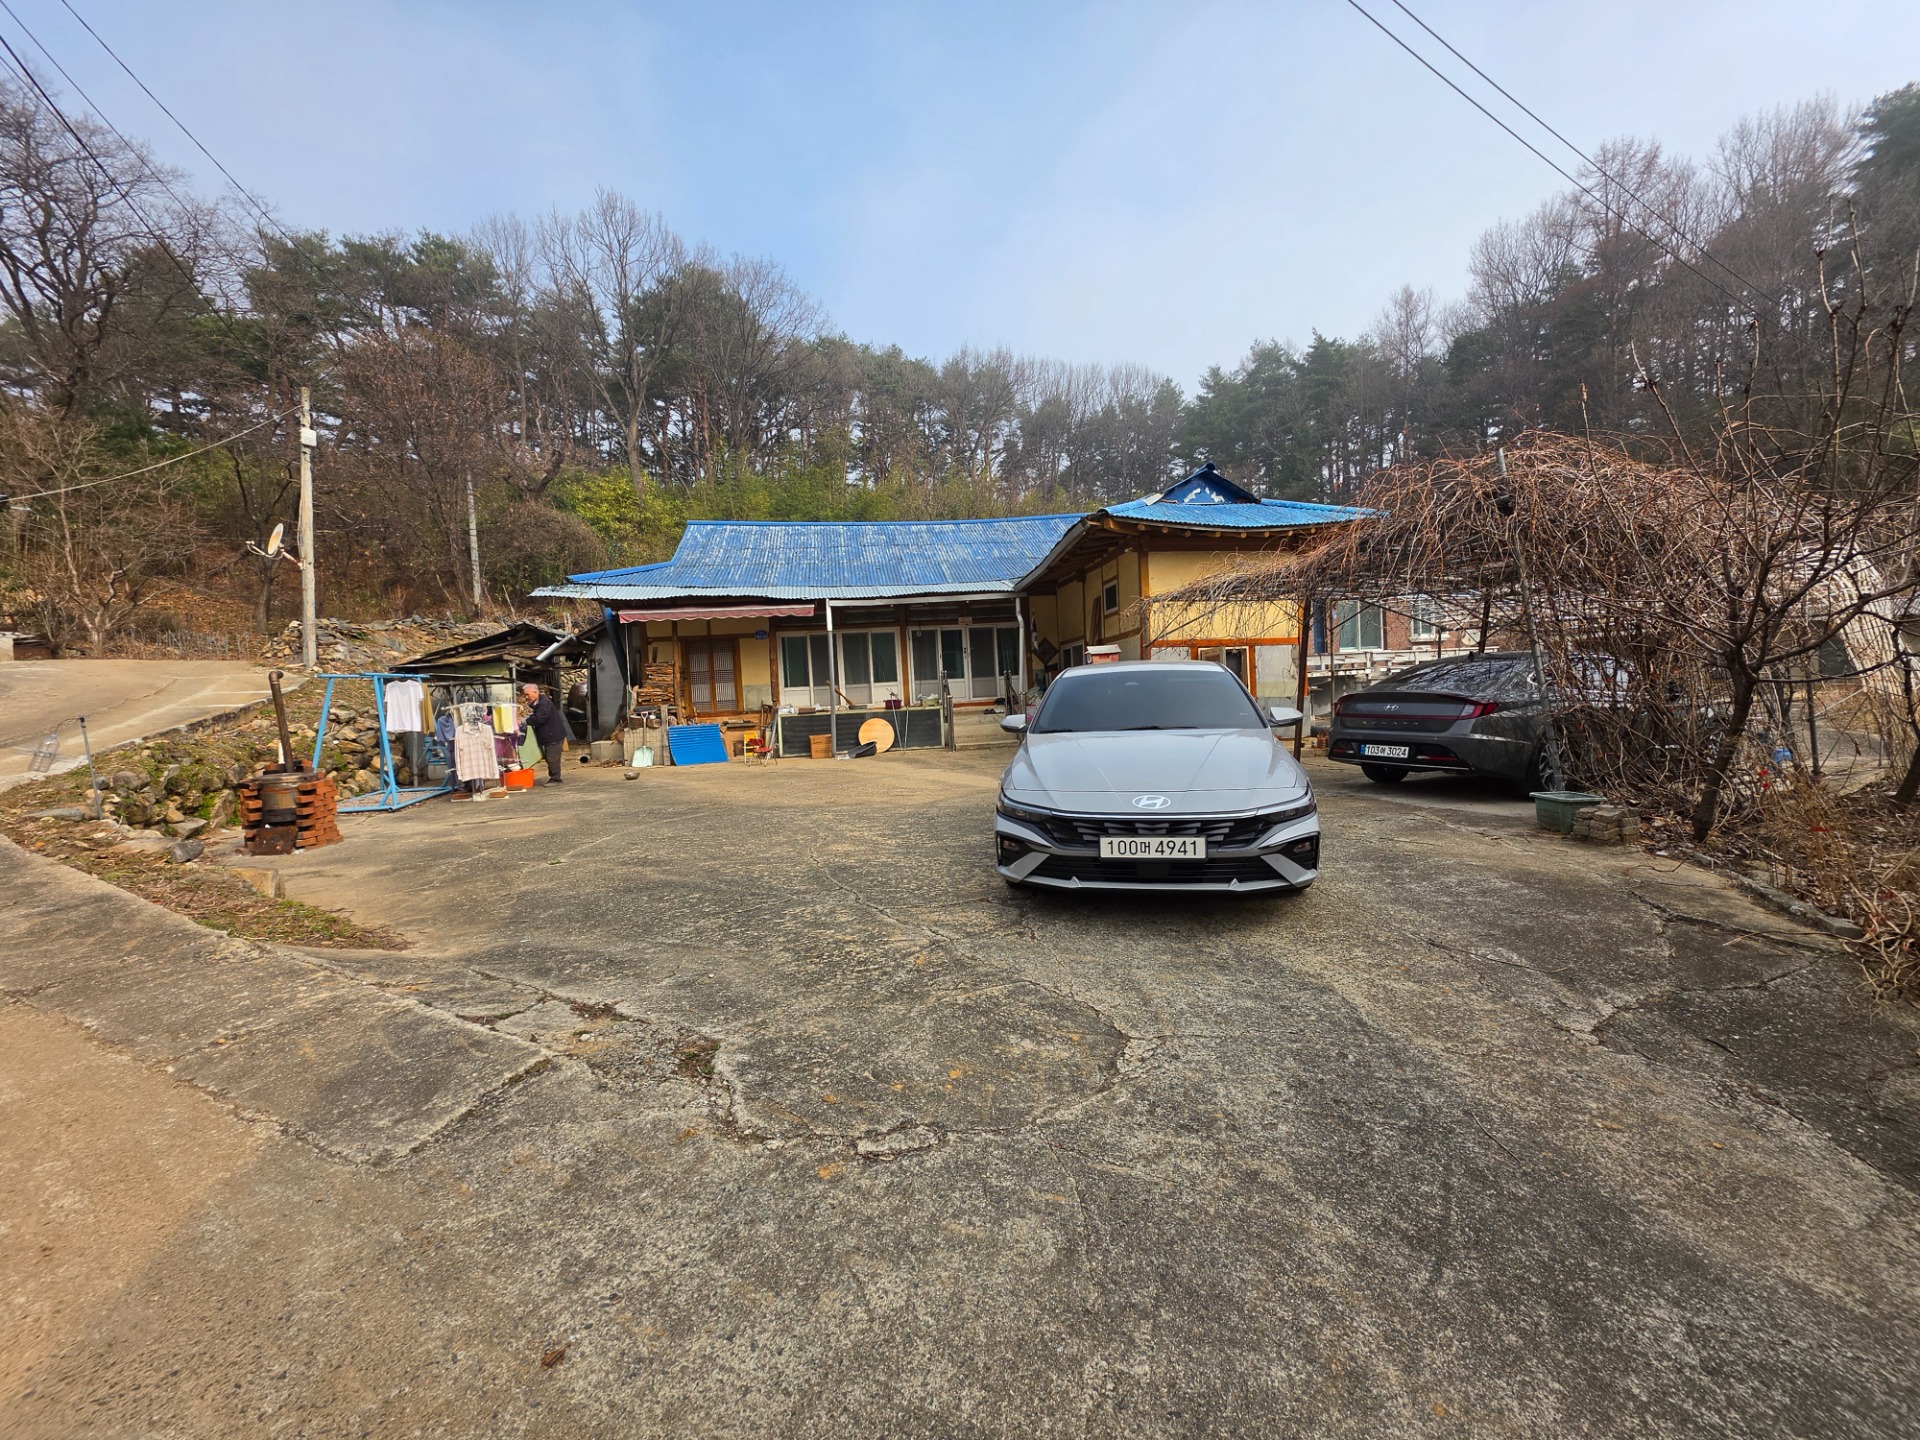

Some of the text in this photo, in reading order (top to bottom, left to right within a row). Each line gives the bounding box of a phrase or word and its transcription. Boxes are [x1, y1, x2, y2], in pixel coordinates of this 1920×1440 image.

[1387, 747, 1407, 757] 3024
[1107, 840, 1197, 855] 100머 4941
